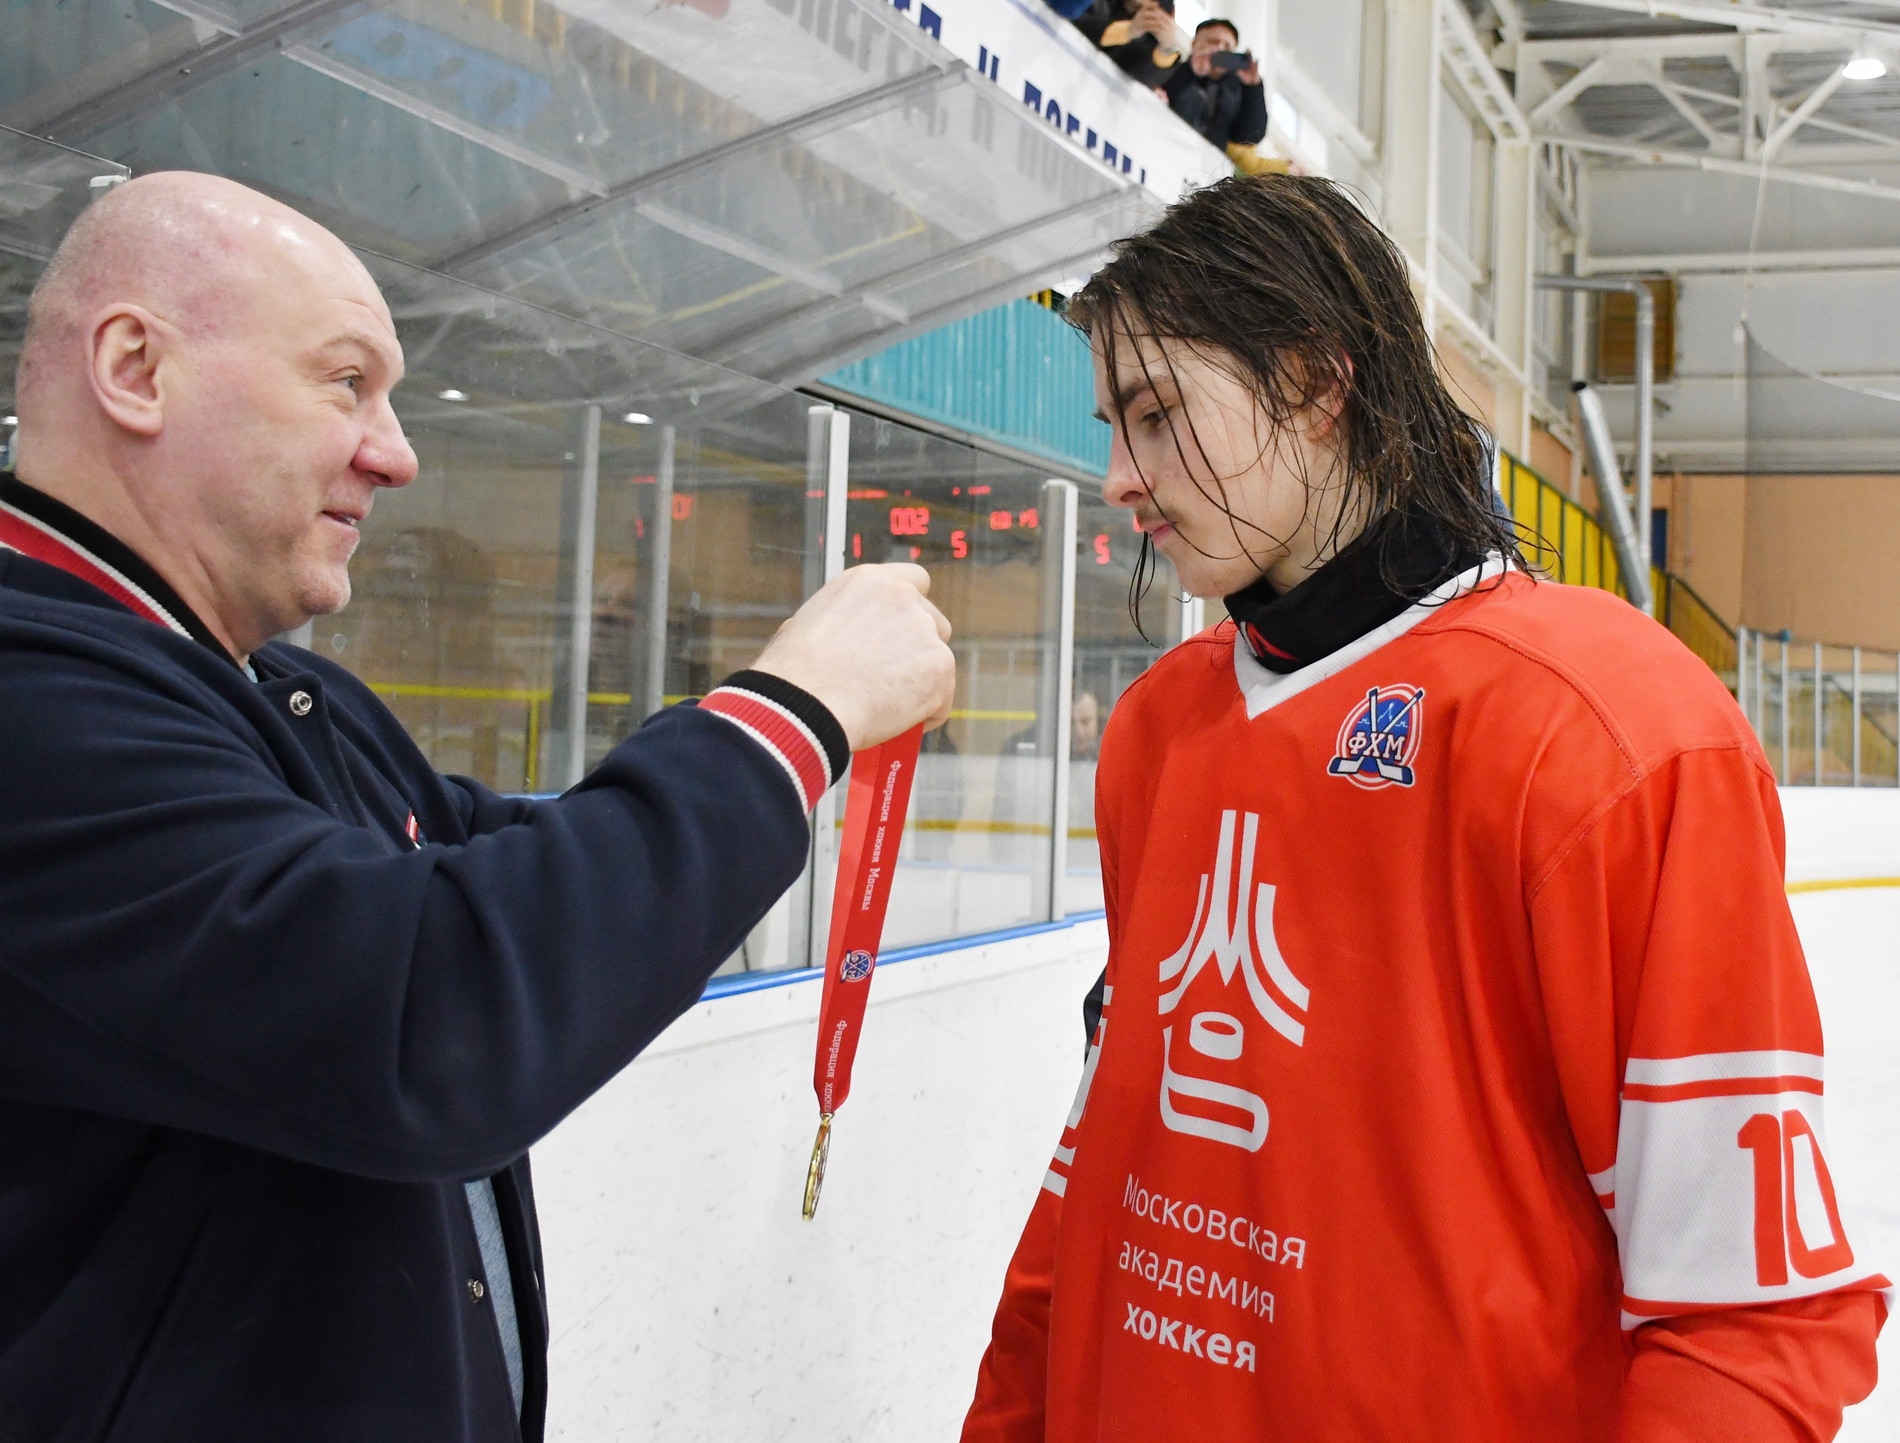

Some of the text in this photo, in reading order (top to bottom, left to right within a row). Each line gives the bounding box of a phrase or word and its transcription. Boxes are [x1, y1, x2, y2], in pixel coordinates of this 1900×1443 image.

[1347, 731, 1406, 761] ФХМ
[861, 760, 902, 911] Федерация хоккея Москвы
[824, 1020, 848, 1113] Федерация хокке
[1122, 1173, 1307, 1269] Московская
[1737, 1109, 1855, 1287] 10
[1119, 1240, 1275, 1324] академия
[1123, 1302, 1256, 1373] хоккея
